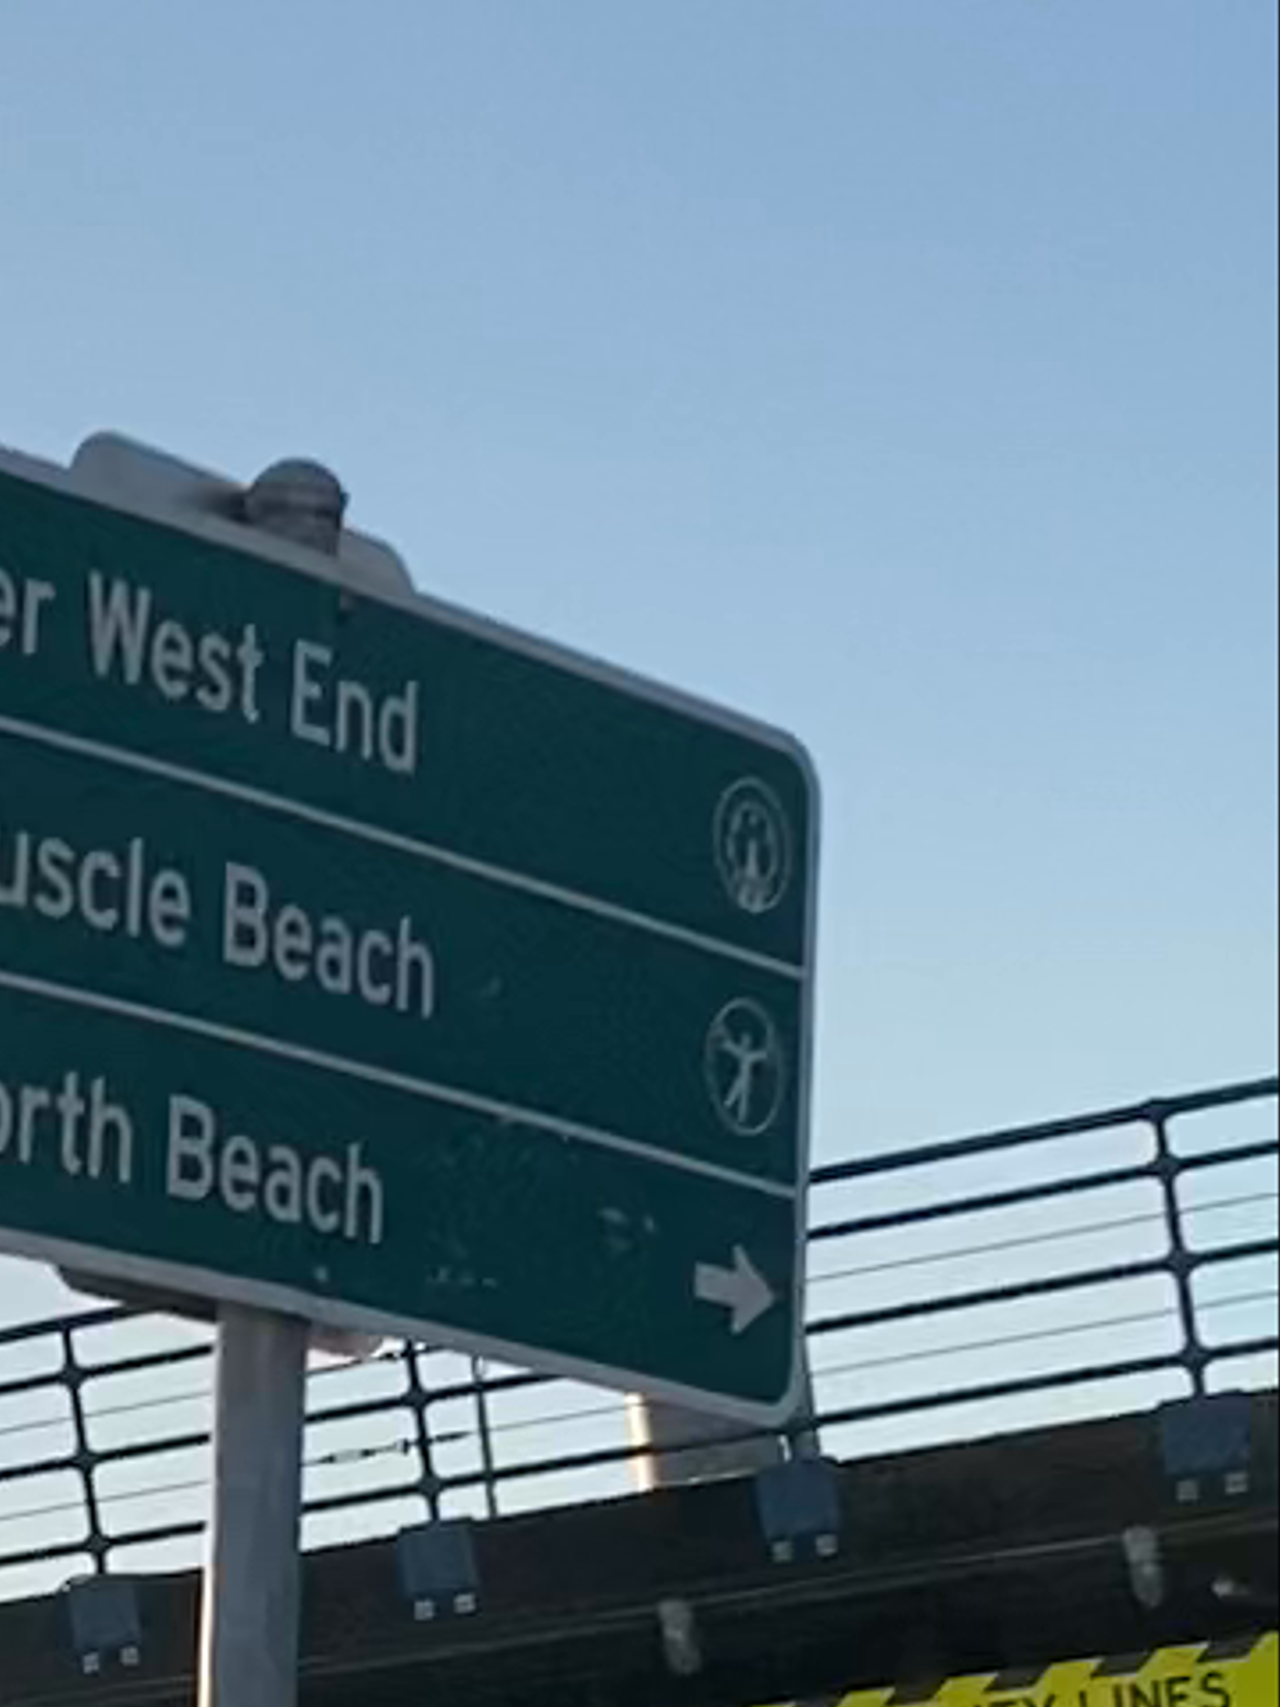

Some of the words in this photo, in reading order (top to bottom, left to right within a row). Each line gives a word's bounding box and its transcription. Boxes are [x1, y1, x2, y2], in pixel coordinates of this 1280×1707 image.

[88, 569, 264, 724] West
[290, 638, 420, 775] End
[223, 860, 435, 1020] Beach
[166, 1094, 383, 1245] Beach
